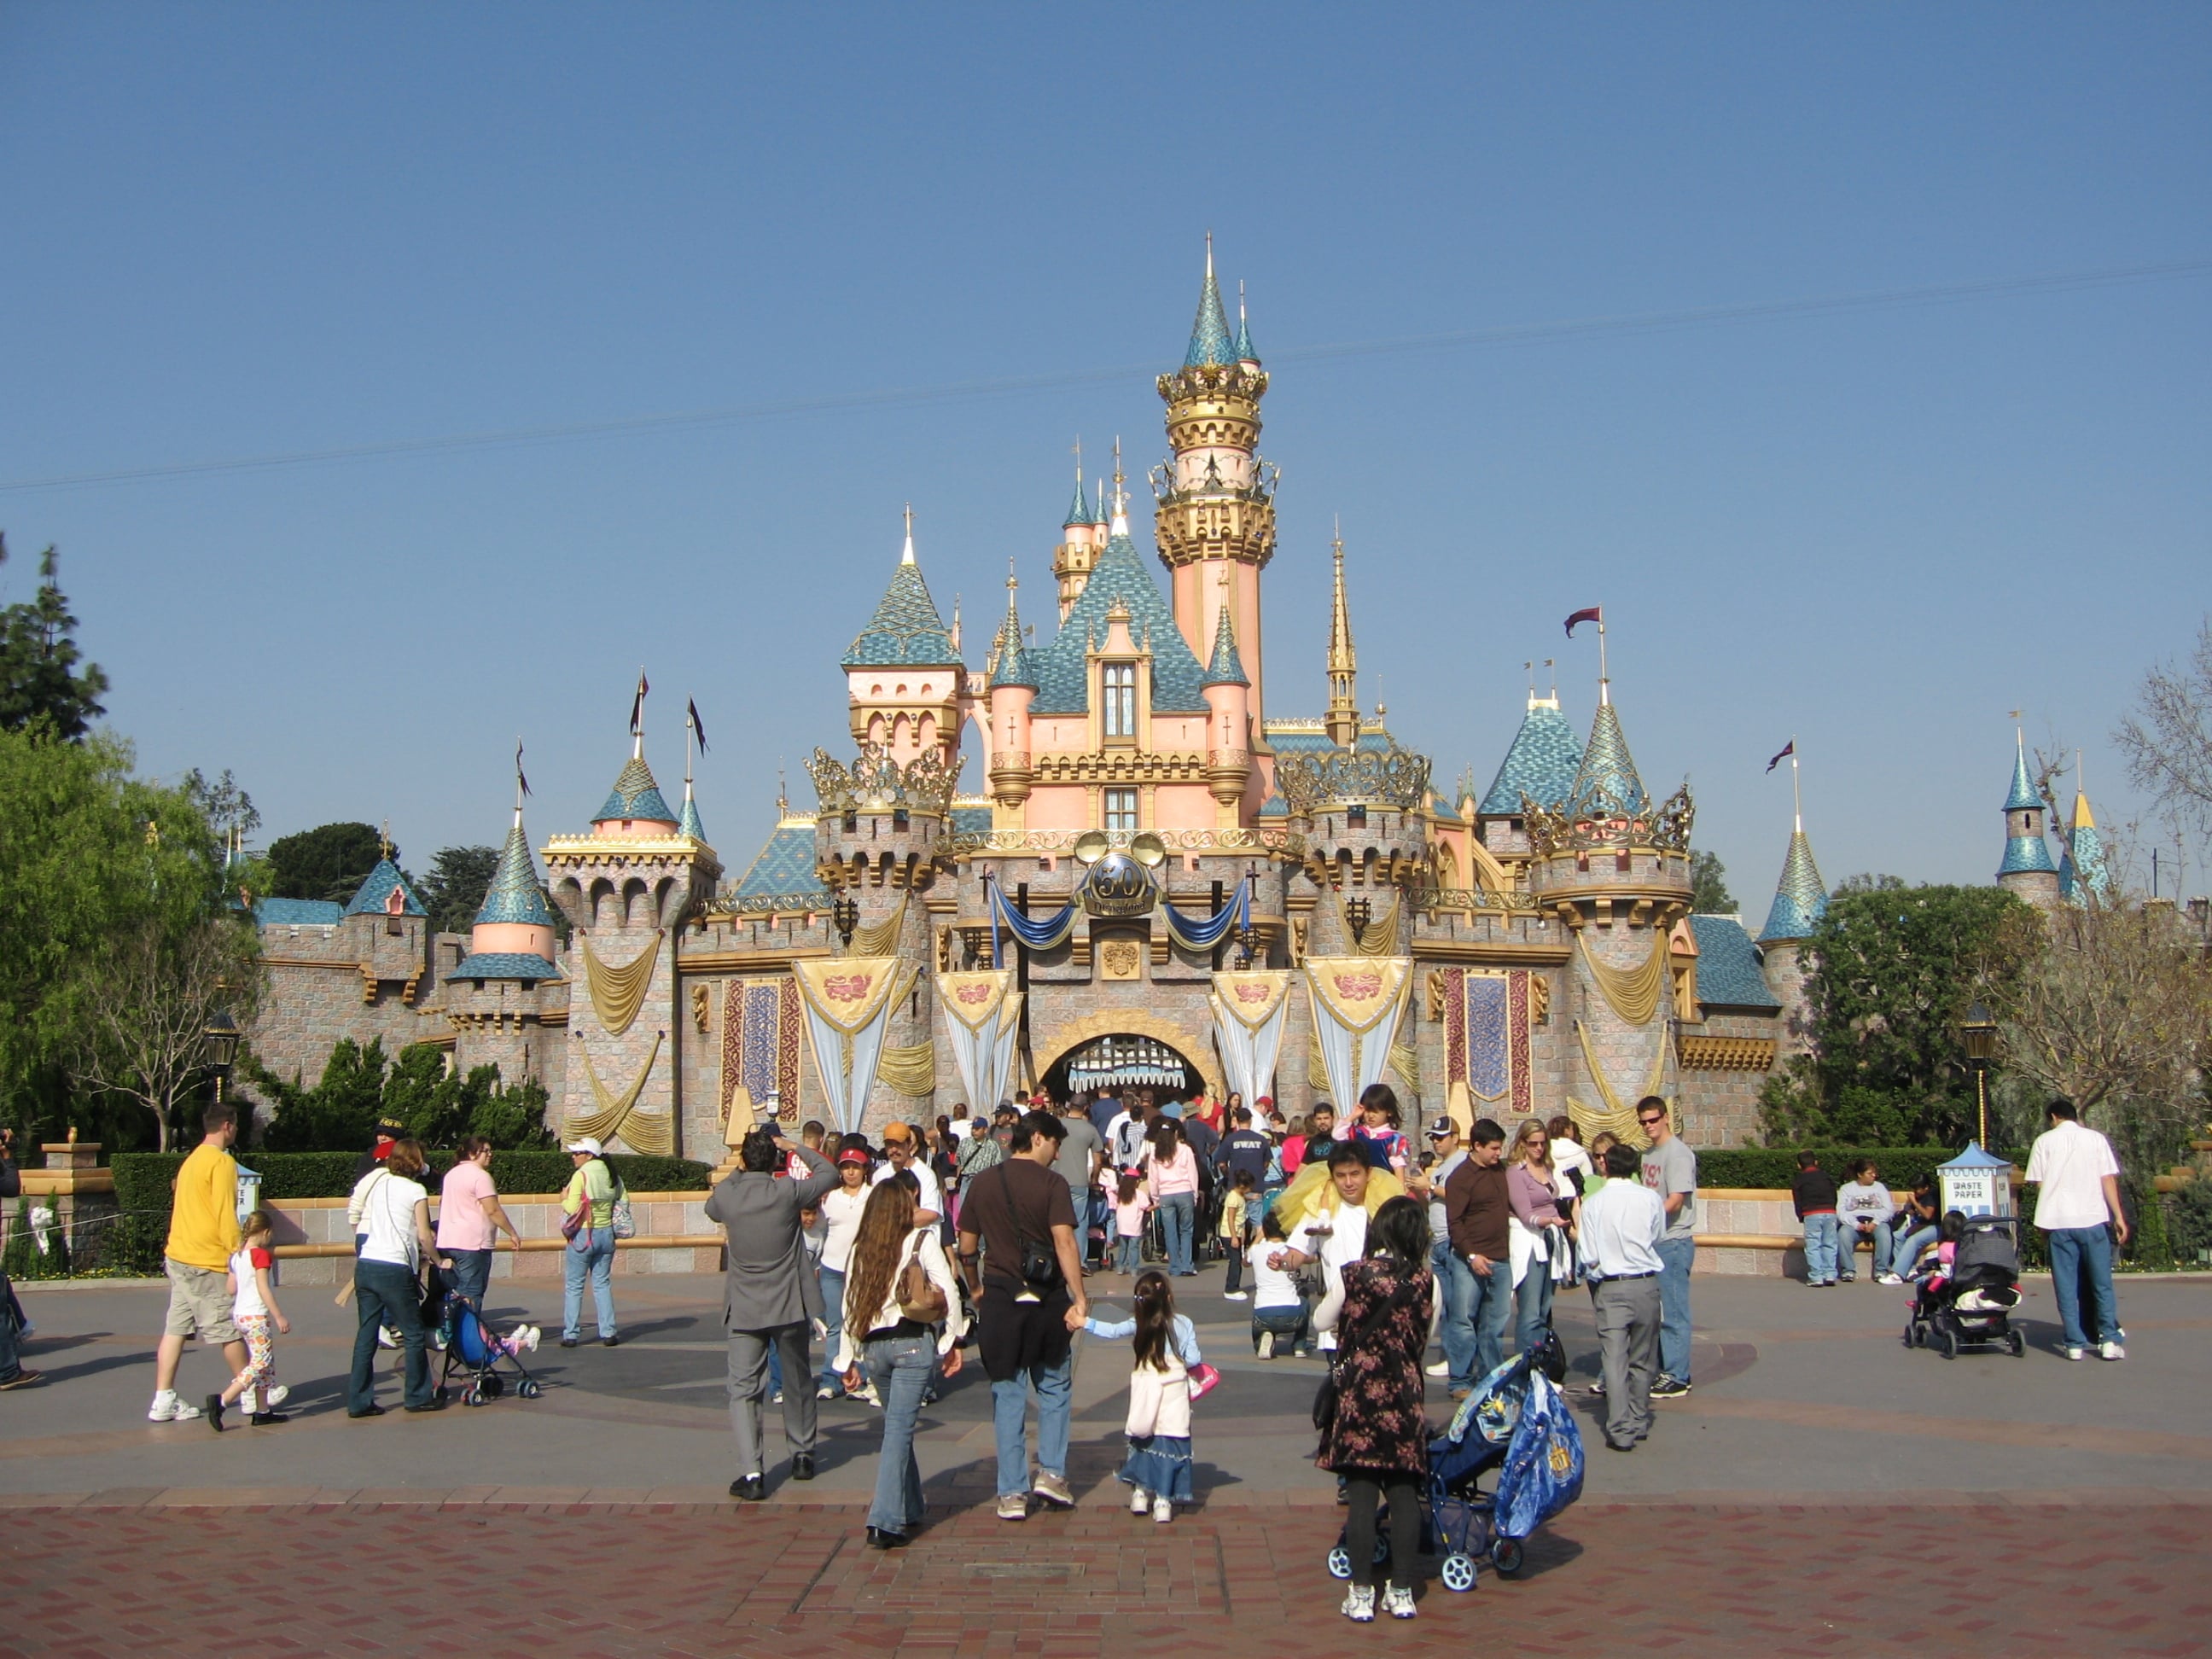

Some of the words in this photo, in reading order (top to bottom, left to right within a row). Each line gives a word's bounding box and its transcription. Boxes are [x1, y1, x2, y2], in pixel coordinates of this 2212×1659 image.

[1099, 866, 1138, 896] 50
[1094, 901, 1144, 915] Disneyland
[1232, 1140, 1262, 1150] SWAT
